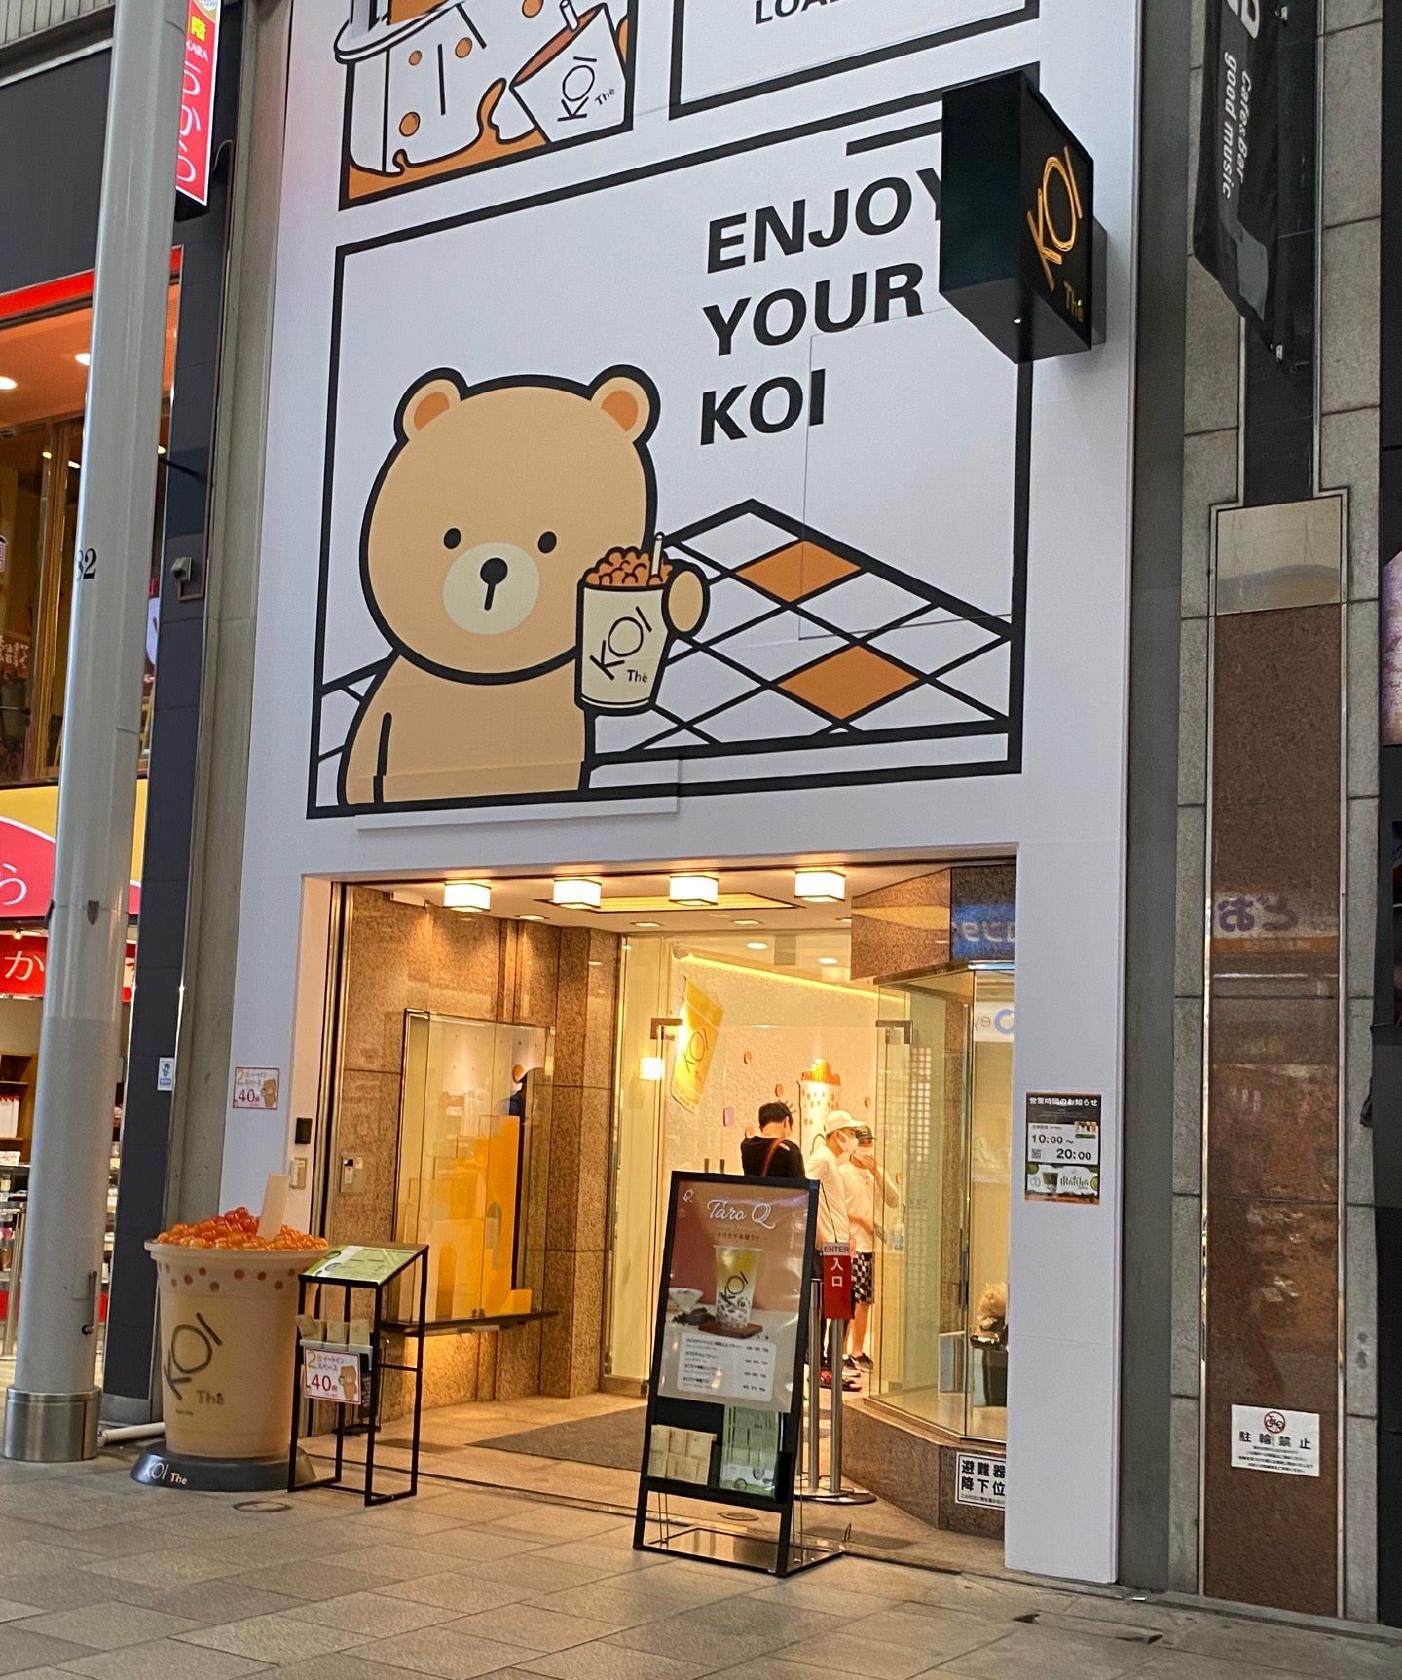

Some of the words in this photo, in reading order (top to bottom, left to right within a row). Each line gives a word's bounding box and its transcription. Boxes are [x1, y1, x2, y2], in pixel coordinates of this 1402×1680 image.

[557, 56, 597, 122] KOI
[1224, 51, 1237, 120] good
[1222, 122, 1235, 199] music
[1026, 146, 1083, 291] KOI
[702, 262, 924, 356] YOUR
[700, 368, 826, 446] KOI
[589, 606, 652, 680] KOI
[1031, 1134, 1063, 1144] 10:00
[1056, 1148, 1092, 1160] 20:00
[751, 1202, 776, 1230] Q
[824, 1245, 850, 1253] ENTER
[719, 1271, 749, 1306] KOI
[830, 1257, 844, 1288] 入口
[163, 1312, 223, 1401] KOI
[1239, 1431, 1312, 1450] 駐輪禁止
